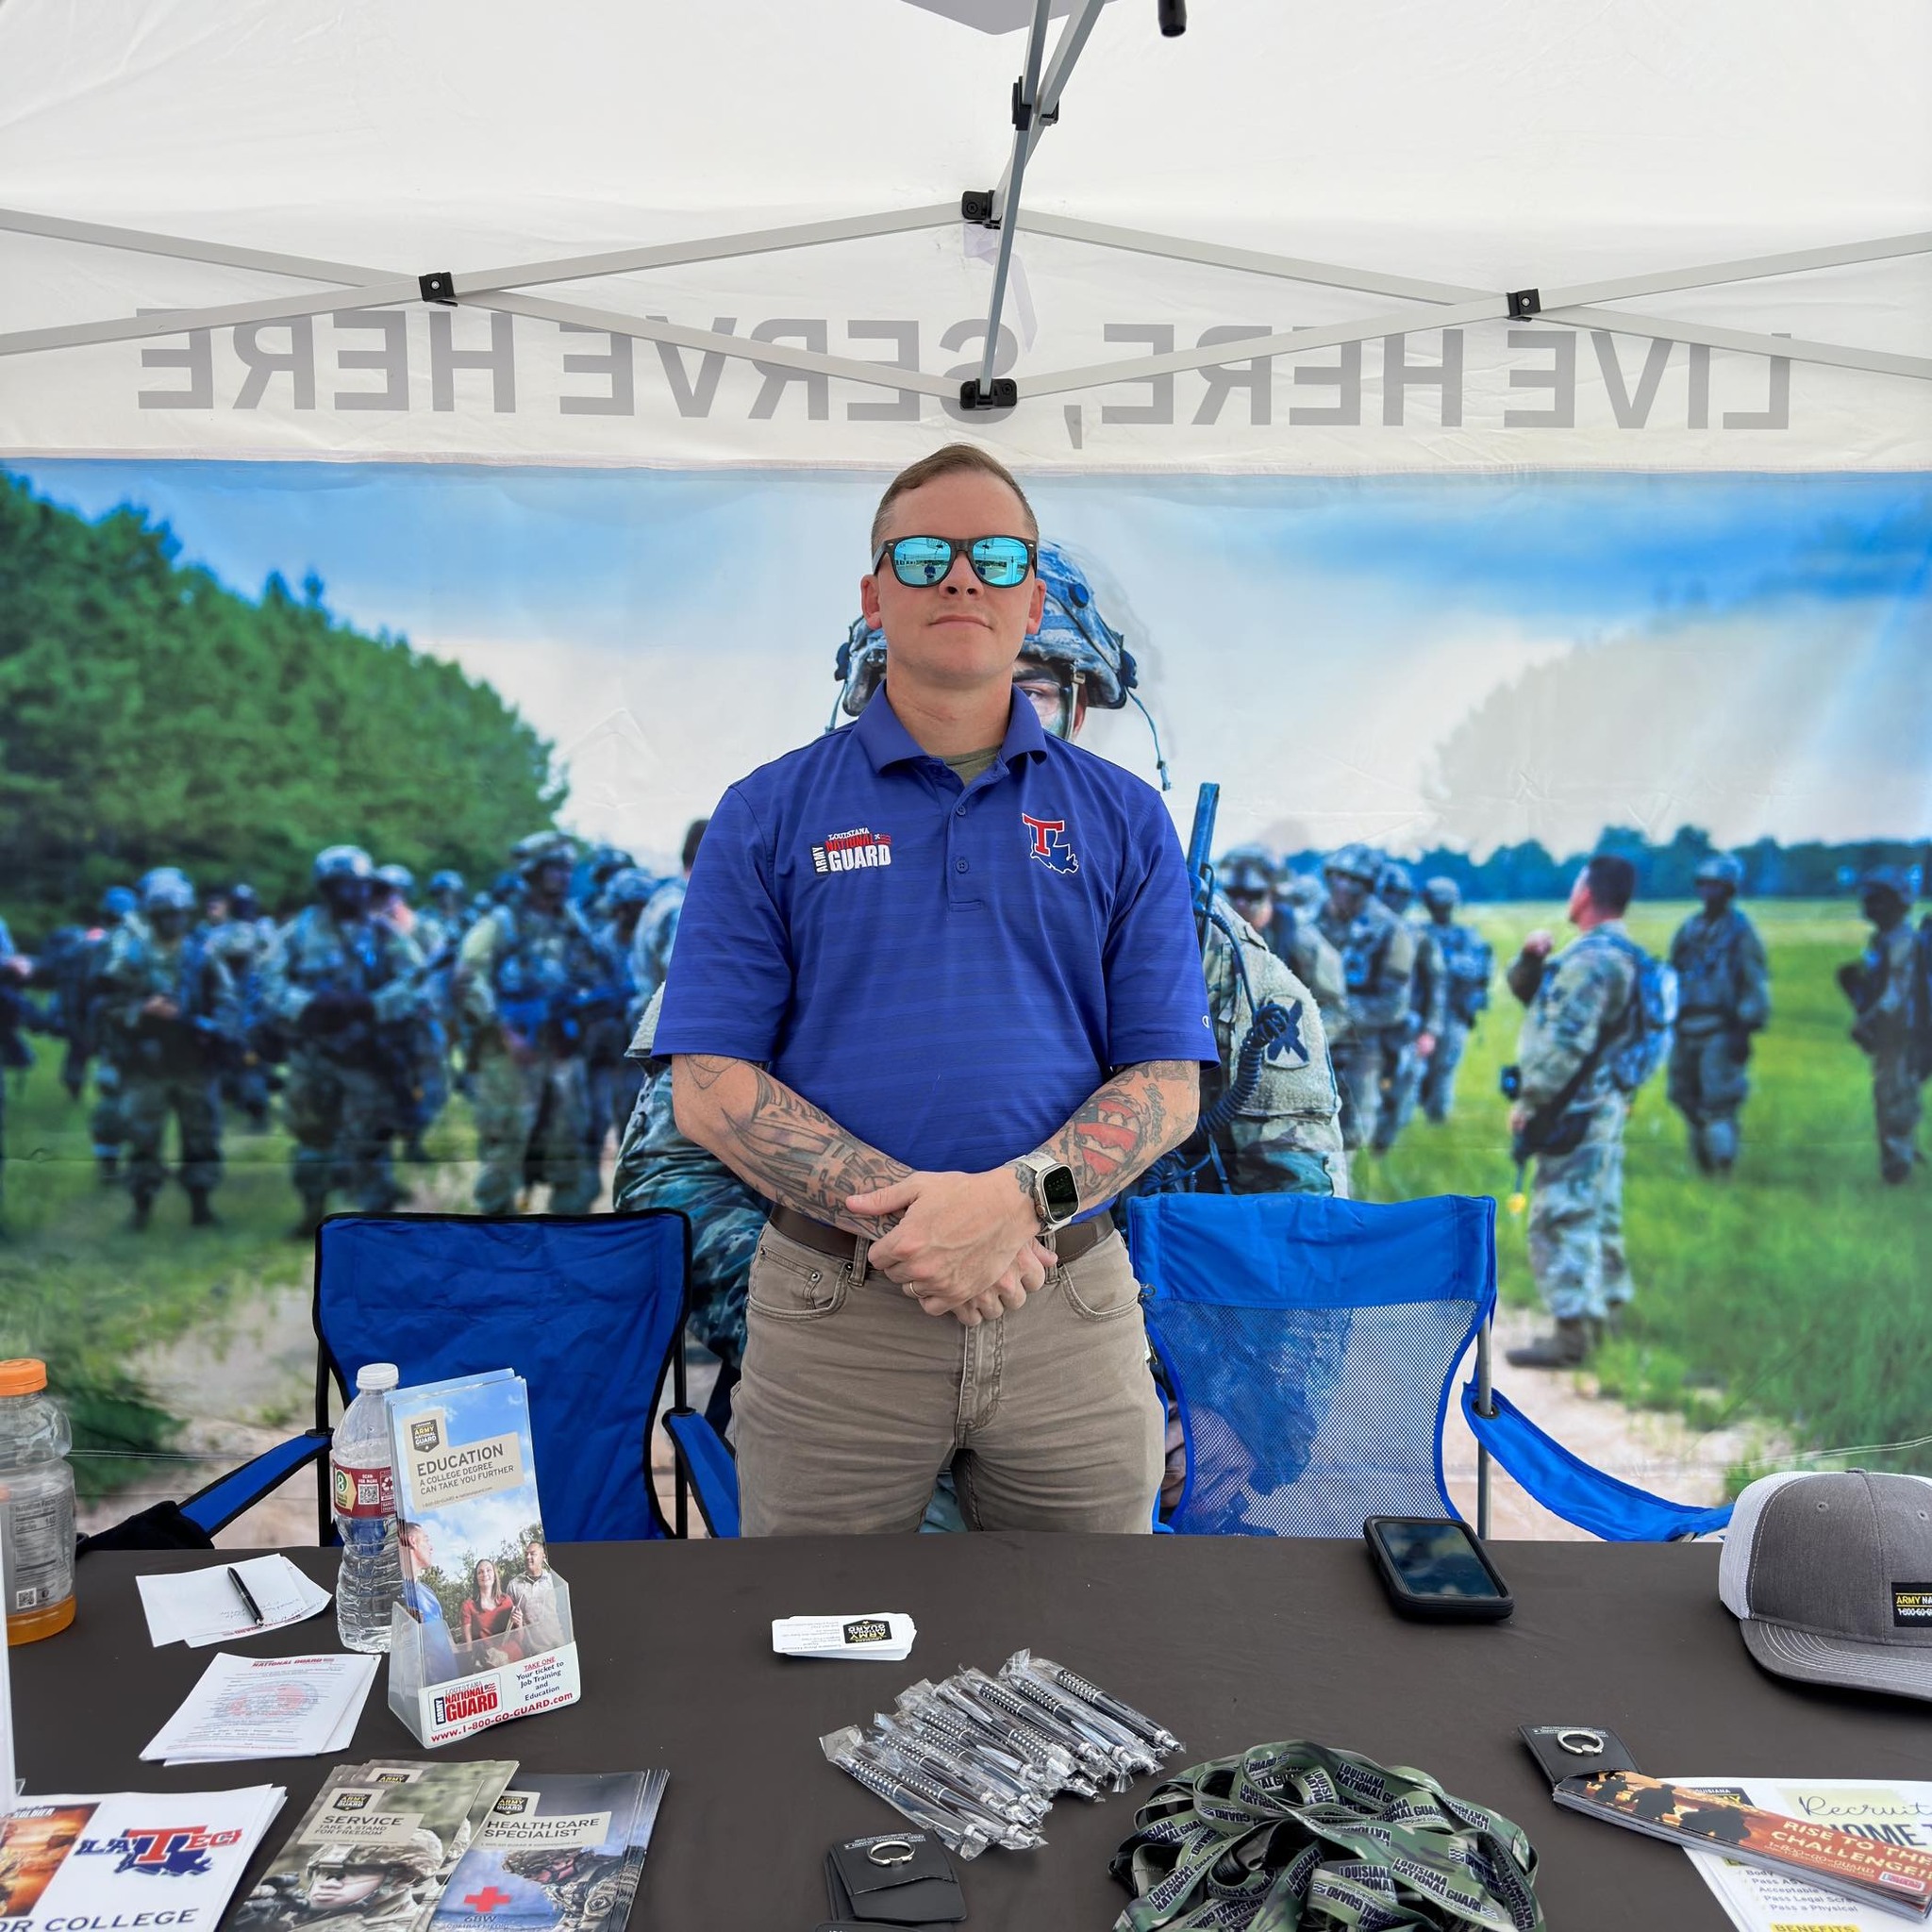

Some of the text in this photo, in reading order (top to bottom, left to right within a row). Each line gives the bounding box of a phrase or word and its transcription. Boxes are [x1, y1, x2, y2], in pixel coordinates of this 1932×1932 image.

[824, 833, 874, 852] NATIONAL
[827, 827, 870, 841] LOUISIANA
[813, 846, 827, 874] ARMY
[828, 844, 891, 872] GUARD
[415, 1425, 435, 1435] ARMY
[417, 1443, 504, 1476] EDUCATION
[420, 1465, 514, 1495] CAN TAKE YOU FURTHER
[426, 1470, 460, 1486] COLLEGE
[462, 1461, 493, 1475] DEGREE
[516, 1672, 533, 1681] Your
[535, 1665, 555, 1675] ticket
[524, 1657, 556, 1671] TAKE ONE
[521, 1669, 561, 1689] Job Training
[536, 1681, 548, 1690] and
[445, 1686, 484, 1704] NATIONAL
[525, 1686, 560, 1701] Education
[431, 1692, 573, 1742] www.1-800-GO-GUARD.com
[435, 1699, 445, 1723] ARMY
[445, 1692, 498, 1722] GUARD
[1249, 1757, 1276, 1772] GUARD
[1340, 1762, 1387, 1790] LOUISIANA
[1303, 1774, 1324, 1804] NATIO
[1312, 1770, 1335, 1803] LOUISI
[1335, 1771, 1381, 1801] NATIONAL
[323, 1816, 404, 1825] SERVICE
[487, 1818, 600, 1829] HEALTH CARE
[1215, 1808, 1250, 1822] GUARD
[484, 1828, 581, 1839] SPECIALIST
[1179, 1820, 1203, 1835] GUA
[1837, 1824, 1926, 1846] OME
[1783, 1821, 1932, 1866] RISE TO THE
[1285, 1849, 1321, 1886] LOUISIANA
[1396, 1858, 1448, 1886] LOUISIANA
[1148, 1865, 1191, 1904] LOUISIANA
[1154, 1869, 1193, 1911] NATIONAL
[1392, 1865, 1445, 1895] NATIONAL
[1446, 1890, 1482, 1912] GUARD
[1326, 1887, 1363, 1910] GUARD
[1811, 1904, 1858, 1912] Physical
[45, 1908, 199, 1932] COLLEGE
